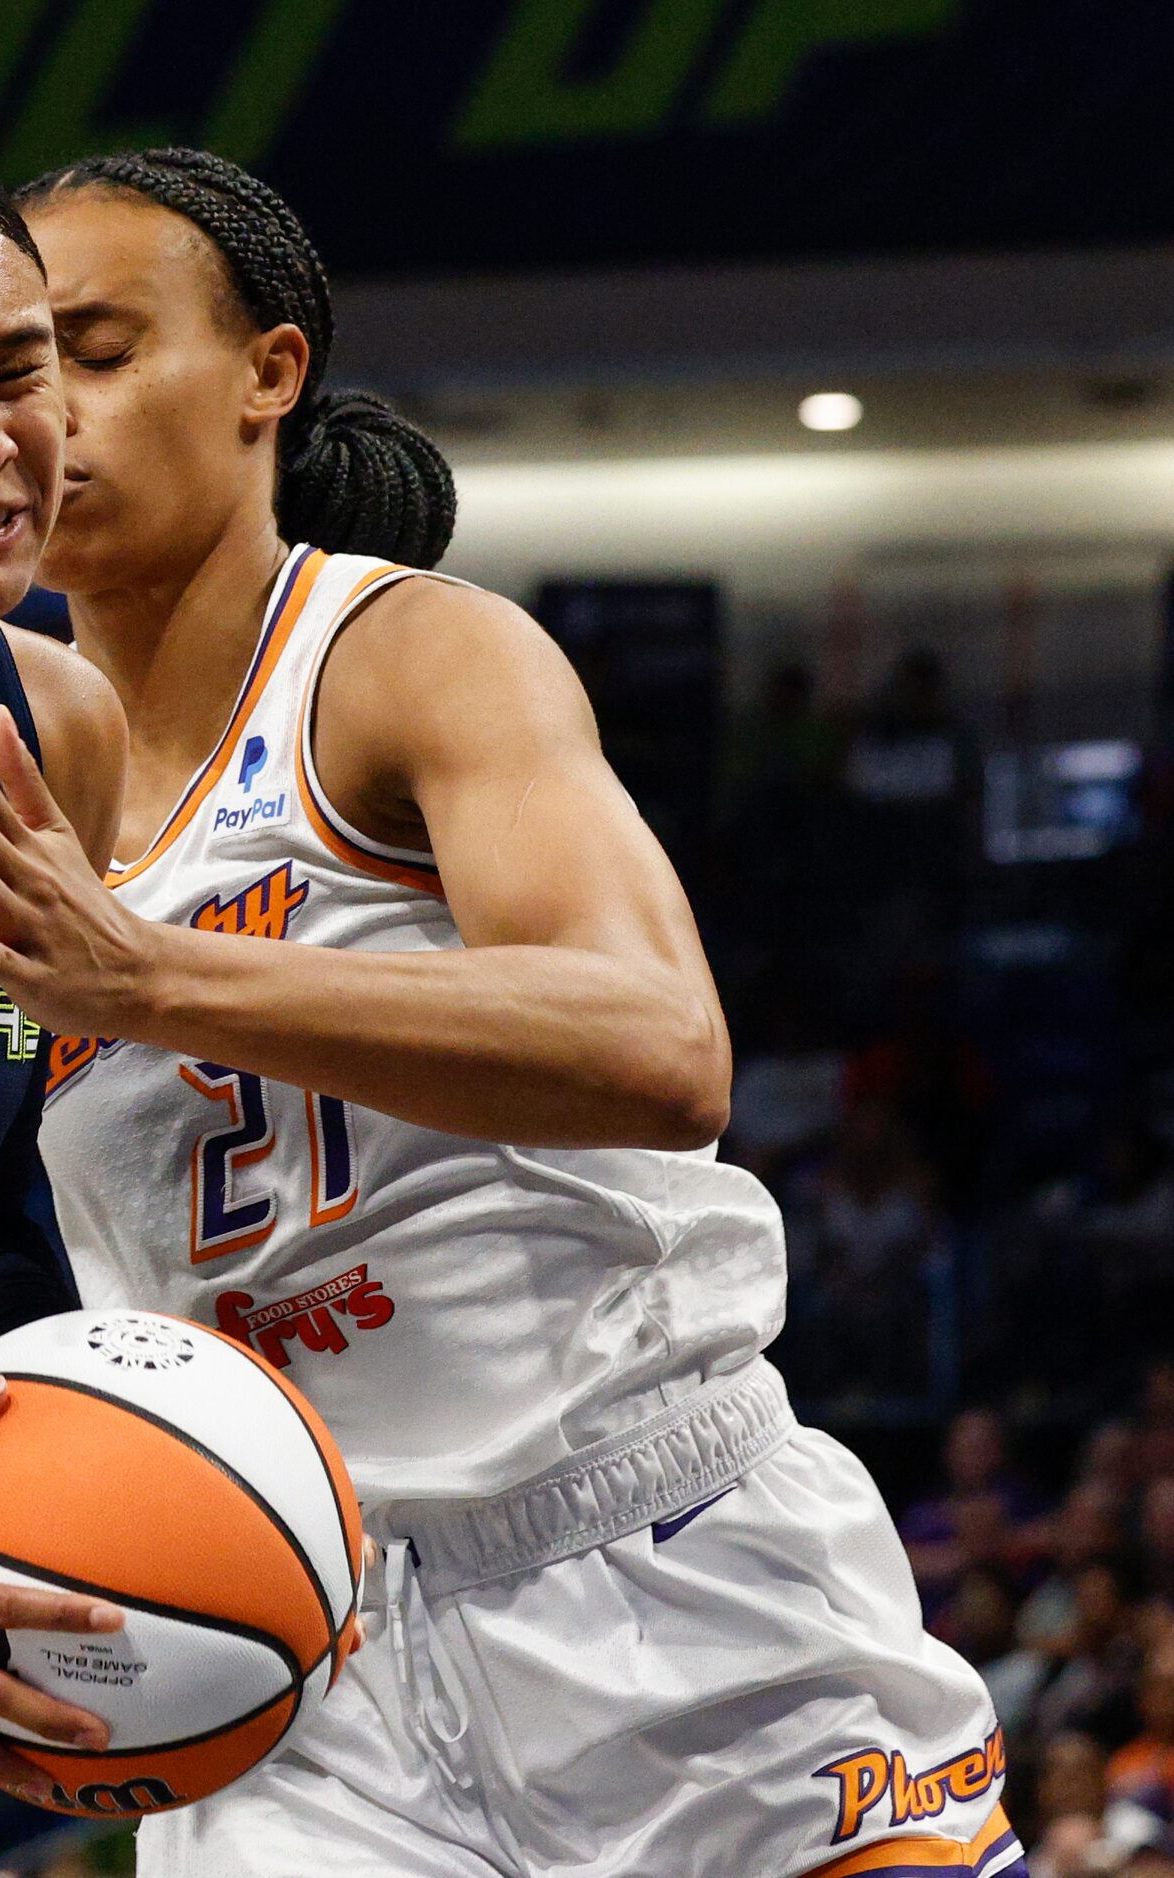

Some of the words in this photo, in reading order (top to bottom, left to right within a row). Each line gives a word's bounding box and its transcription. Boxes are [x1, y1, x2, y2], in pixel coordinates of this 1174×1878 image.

[213, 794, 286, 832] PayPal
[179, 1062, 359, 1265] 21
[246, 1302, 294, 1330] FOOD
[297, 1270, 362, 1308] STORES
[50, 1664, 133, 1687] OFFICIAL
[92, 1658, 148, 1672] GAME
